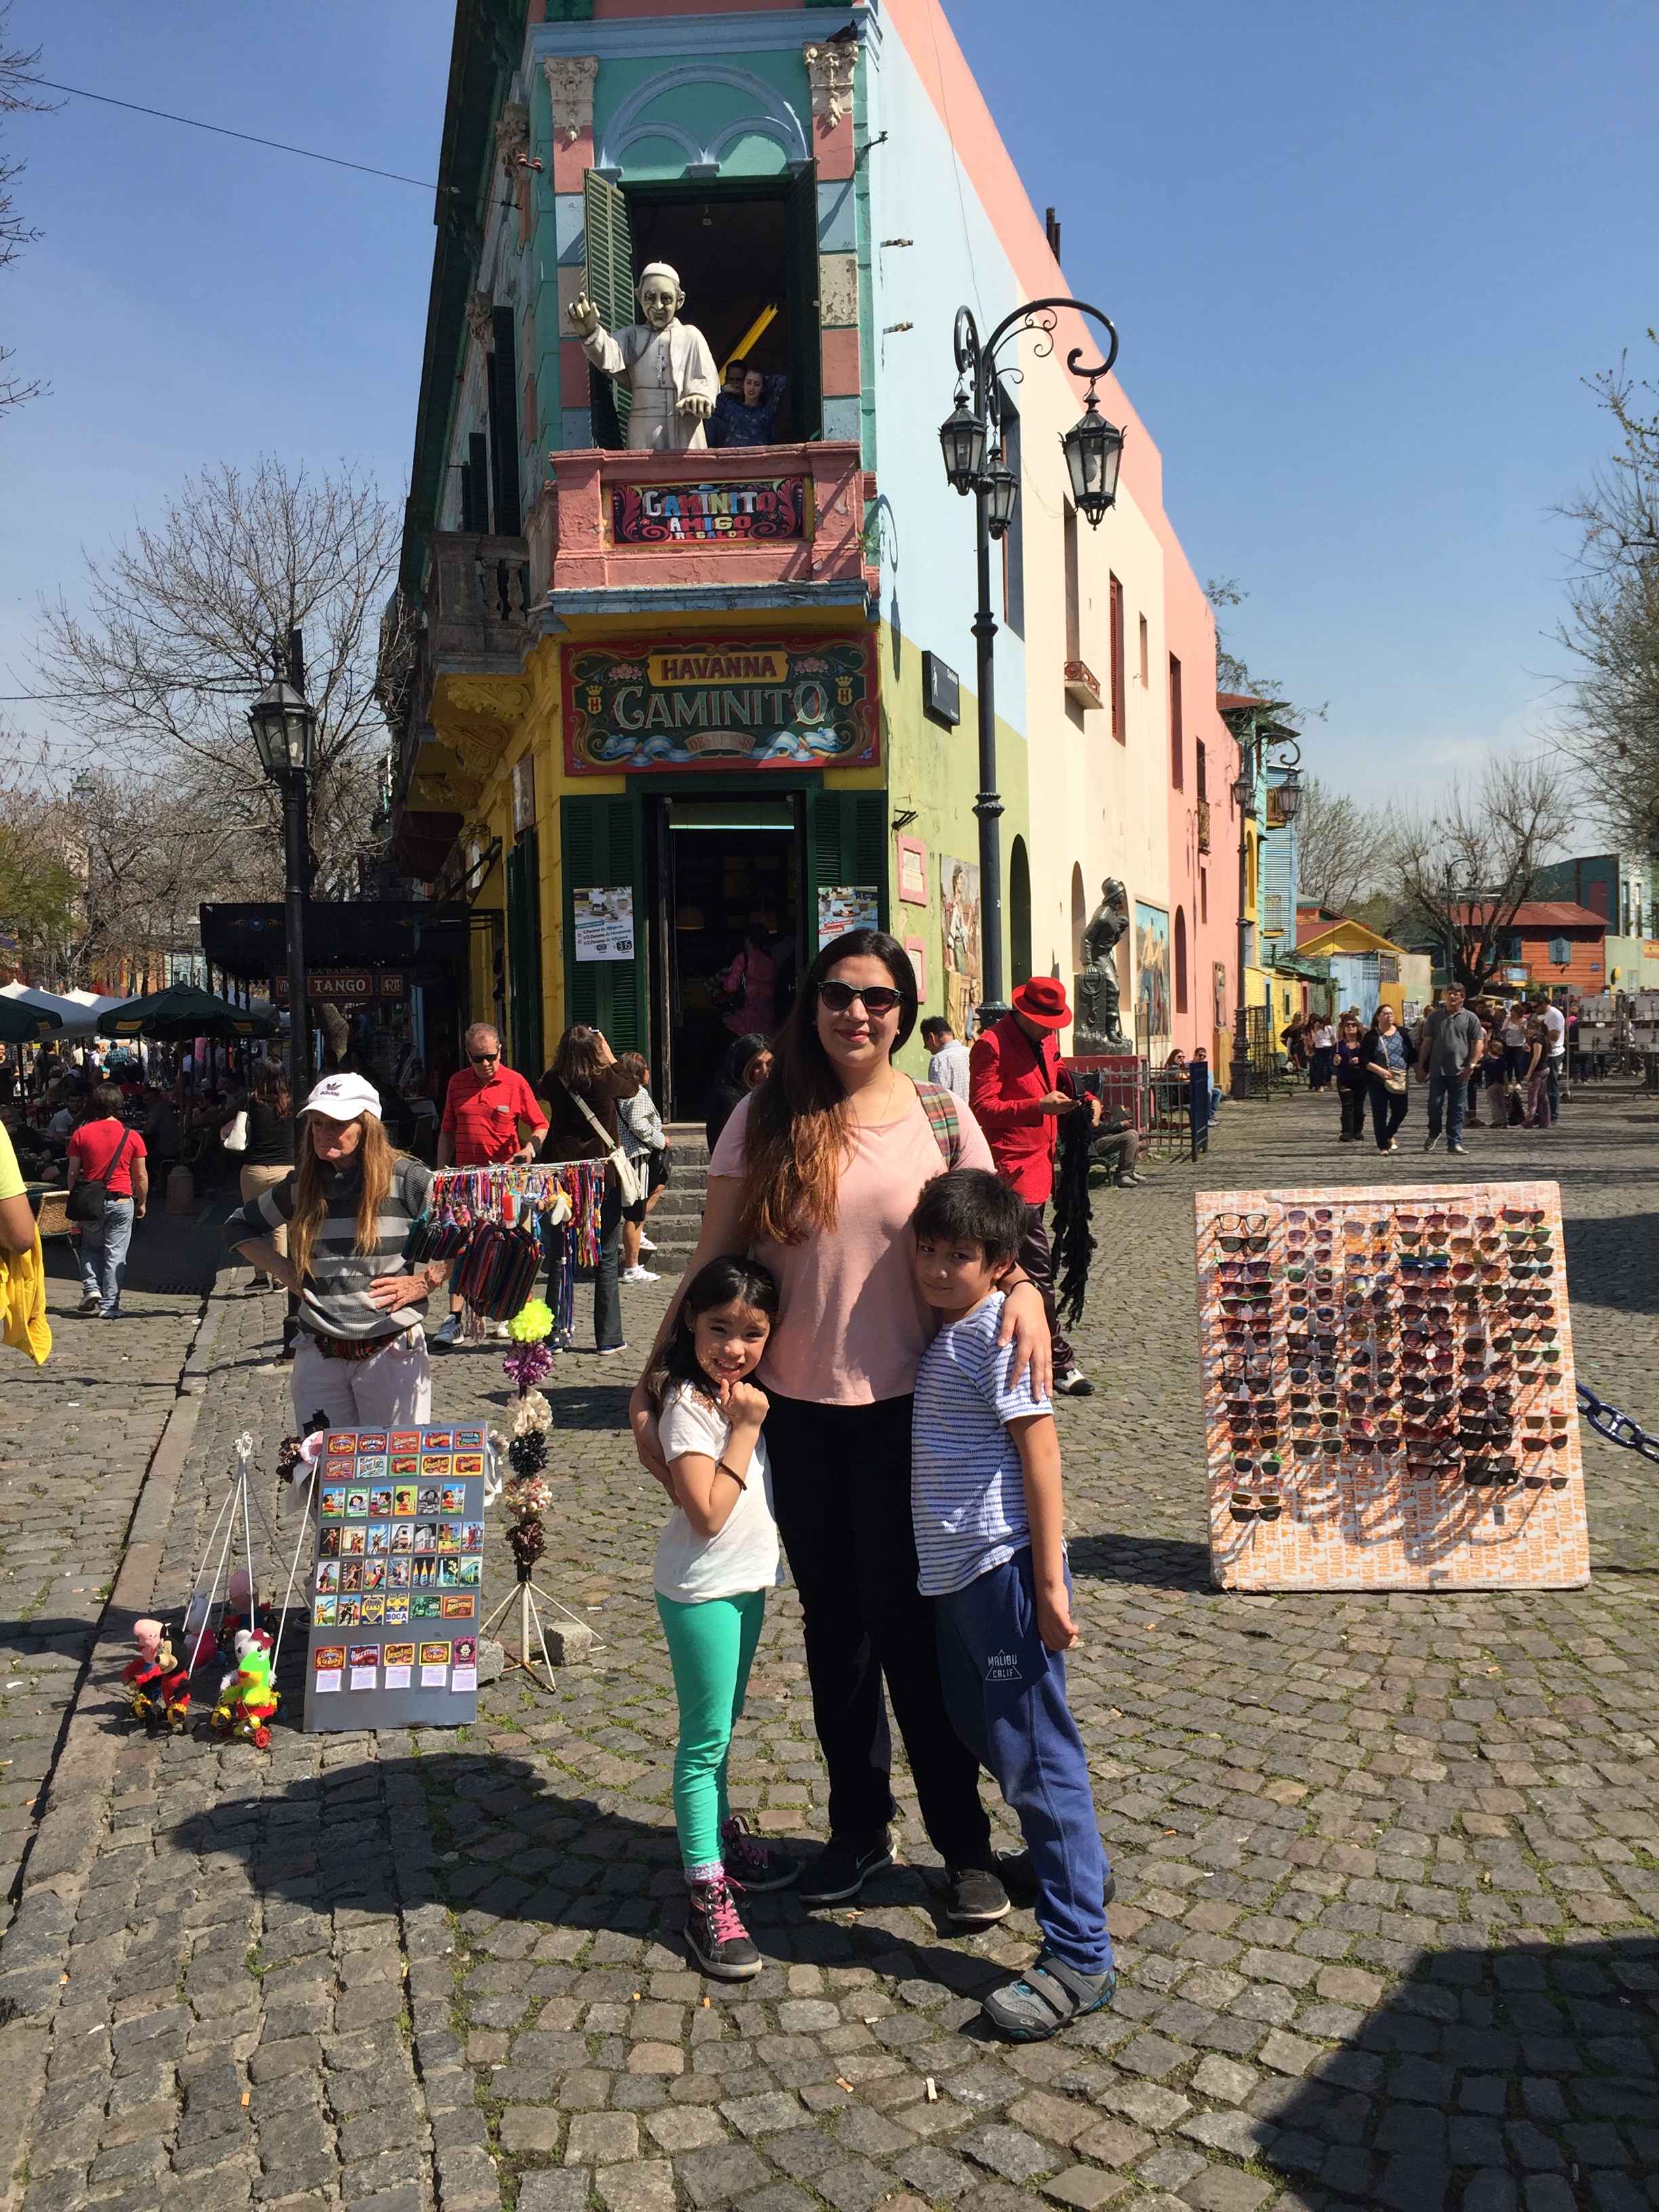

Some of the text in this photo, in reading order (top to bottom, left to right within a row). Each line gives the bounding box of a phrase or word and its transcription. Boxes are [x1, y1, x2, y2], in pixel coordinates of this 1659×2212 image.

[644, 491, 777, 517] CAMINITO
[669, 516, 751, 532] AMIGO
[674, 530, 745, 539] REGALOS
[661, 655, 777, 680] HAVANNA
[590, 697, 599, 712] H
[613, 680, 830, 731] CAMINITO
[840, 690, 849, 703] H
[730, 734, 753, 750] 1948
[314, 979, 366, 994] TANGO
[384, 979, 403, 992] ARTE
[1342, 1480, 1355, 1514] FRAGIL
[1418, 1486, 1433, 1520] FRAGIL
[1404, 1505, 1418, 1538] FRAGIL
[1558, 1498, 1573, 1532] FRAGIL
[1252, 1525, 1266, 1558] FRAGIL
[1298, 1528, 1312, 1561] FRAGIL
[1543, 1516, 1558, 1550] FRAGIL
[1283, 1542, 1297, 1576] FRAGIL
[1344, 1530, 1358, 1565] FRAGIL
[1376, 1543, 1391, 1578] FRAGIL
[1469, 1544, 1483, 1578] FRAGIL
[1528, 1535, 1544, 1569] FRAGIL
[1267, 1559, 1282, 1584] AGIL
[1313, 1561, 1328, 1582] AGIL
[1328, 1545, 1343, 1579] FRAGIL
[1361, 1559, 1375, 1582] AGIL
[1408, 1555, 1422, 1584] RAGIL
[1455, 1559, 1469, 1580] AGIL
[988, 1654, 1017, 1666] MALIBU
[993, 1668, 1013, 1678] CALIF
